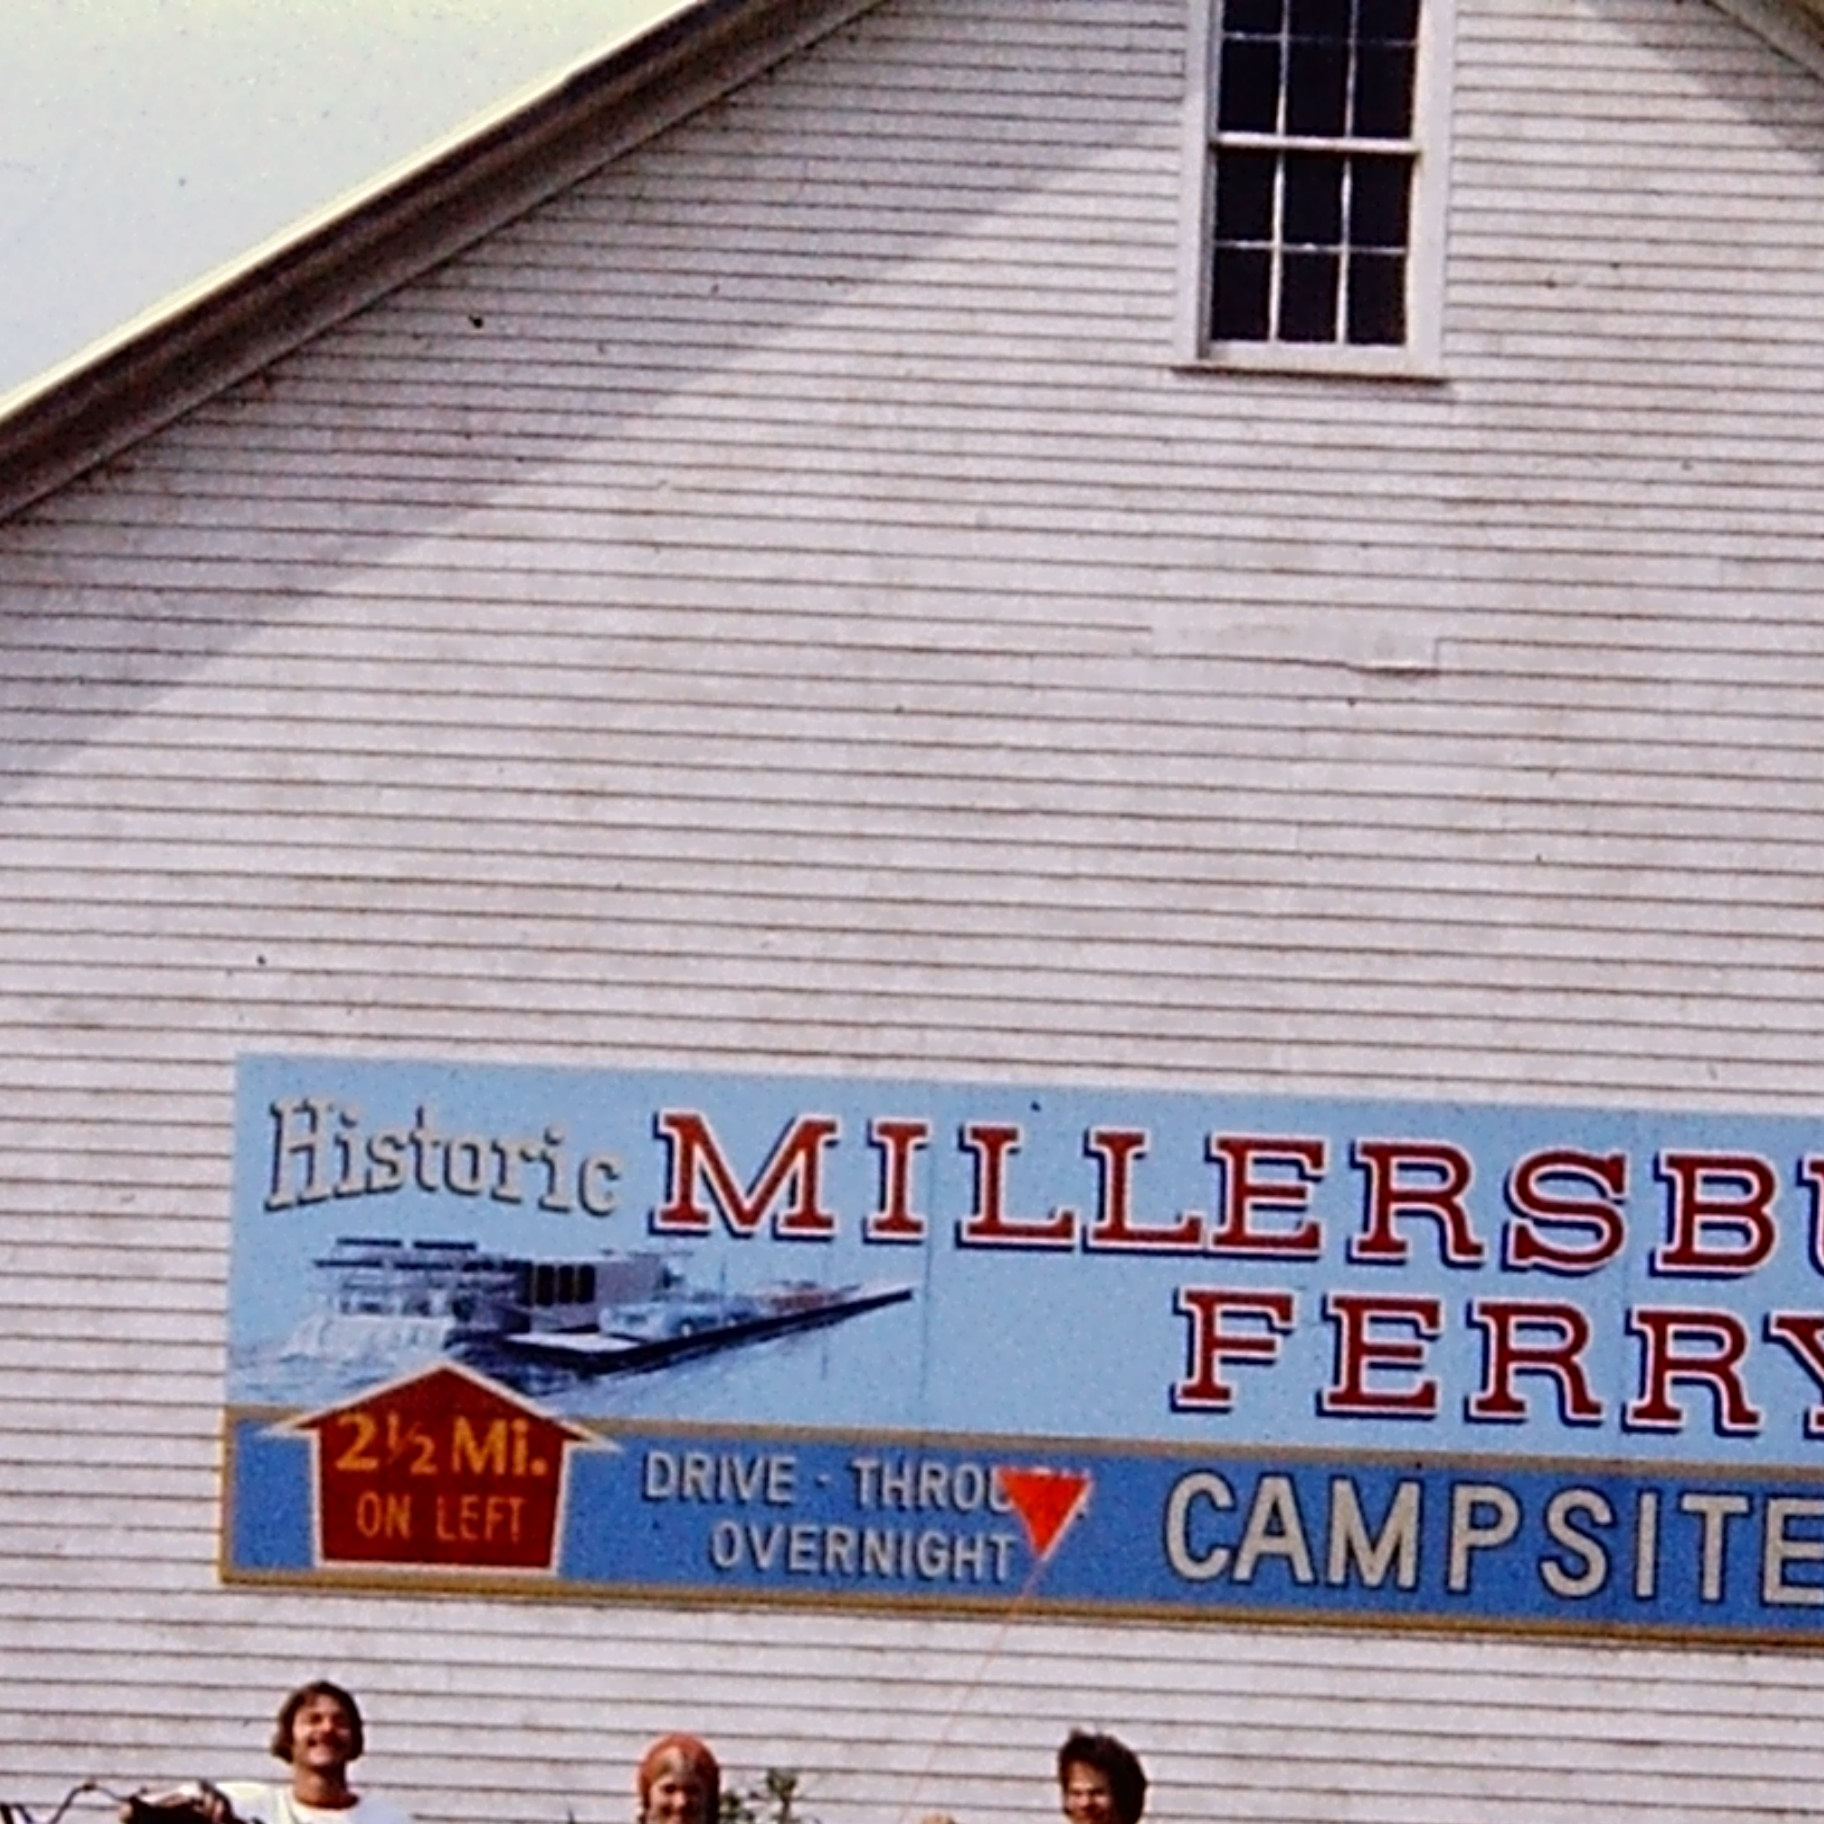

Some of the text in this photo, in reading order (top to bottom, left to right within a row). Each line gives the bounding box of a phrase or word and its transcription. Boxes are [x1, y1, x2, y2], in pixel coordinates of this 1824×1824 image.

[264, 1099, 622, 1217] Historic
[450, 1413, 550, 1478] Mi.
[642, 1450, 798, 1505] DRIVE
[355, 1489, 528, 1545] ON LEFT
[710, 1518, 1019, 1582] OVERNIGHT
